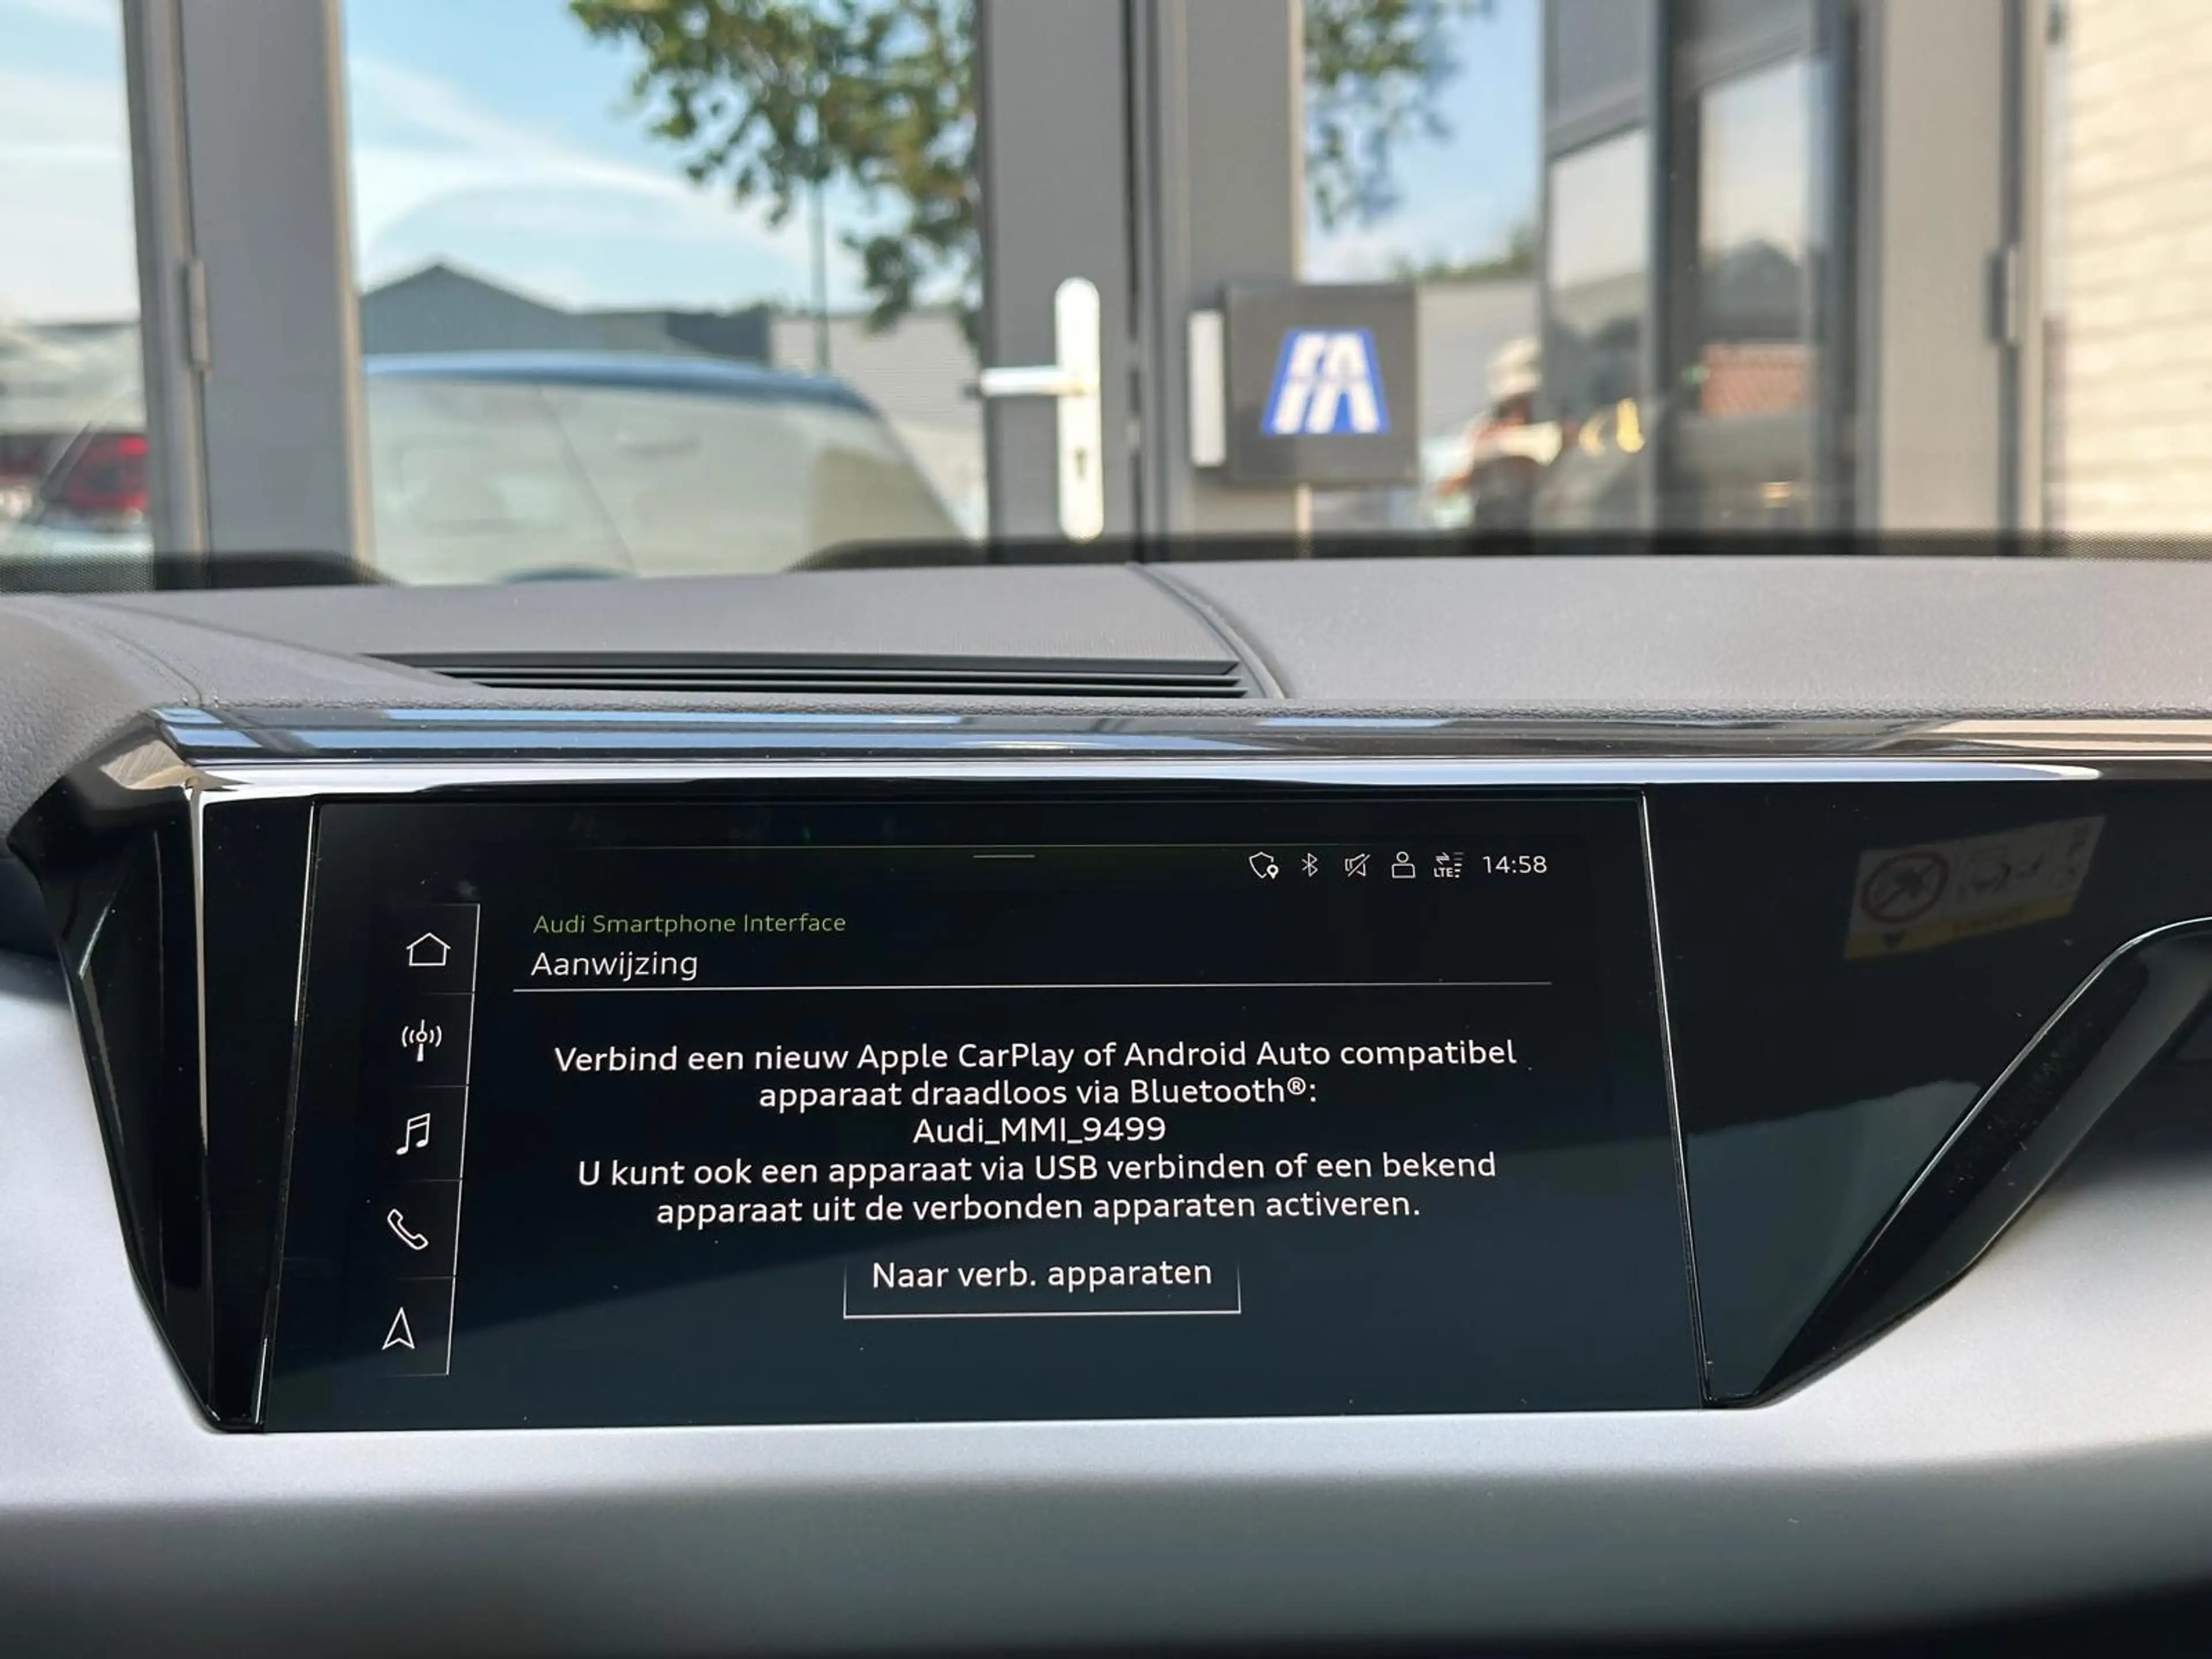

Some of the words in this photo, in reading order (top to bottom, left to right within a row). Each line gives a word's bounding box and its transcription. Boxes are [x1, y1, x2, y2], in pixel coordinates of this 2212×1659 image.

[1434, 867, 1453, 877] LTE
[1483, 855, 1547, 873] 14:58
[533, 915, 585, 933] Audi
[593, 914, 736, 937] Smartphone
[744, 913, 846, 931] Interface
[531, 951, 698, 982] Aanwijzing
[554, 1045, 677, 1072] Verbind
[688, 1051, 744, 1070] een
[755, 1045, 849, 1070] nieuw
[857, 1043, 948, 1075] Apple
[959, 1042, 1075, 1074] CarPlay
[1084, 1041, 1117, 1067] of
[1124, 1040, 1246, 1066] Android
[1255, 1041, 1331, 1065] Auto
[1340, 1039, 1517, 1071] compatibel
[759, 1082, 902, 1114] apparaat
[911, 1080, 1067, 1106] draadloos
[1076, 1079, 1119, 1104] via
[912, 1116, 1166, 1145] Audi_MMI_9499
[579, 1161, 600, 1186] U
[612, 1160, 685, 1185] kunt
[694, 1158, 752, 1184] ook
[762, 1164, 817, 1183] een
[828, 1157, 972, 1190] apparaat
[980, 1155, 1024, 1181] via
[1035, 1154, 1098, 1180] USB
[1107, 1153, 1264, 1180] verbinden
[1275, 1152, 1309, 1178] of
[1316, 1158, 1372, 1178] een
[1382, 1151, 1496, 1177] bekend
[657, 1198, 803, 1230] apparaat
[813, 1195, 856, 1222] uit
[865, 1194, 903, 1221] de
[912, 1192, 1082, 1221] verbonden
[1093, 1193, 1255, 1226] apparaten
[1266, 1191, 1420, 1217] activeren.
[873, 1262, 949, 1289] Naar
[957, 1259, 1036, 1287] verb.
[1047, 1260, 1212, 1293] apparaten
